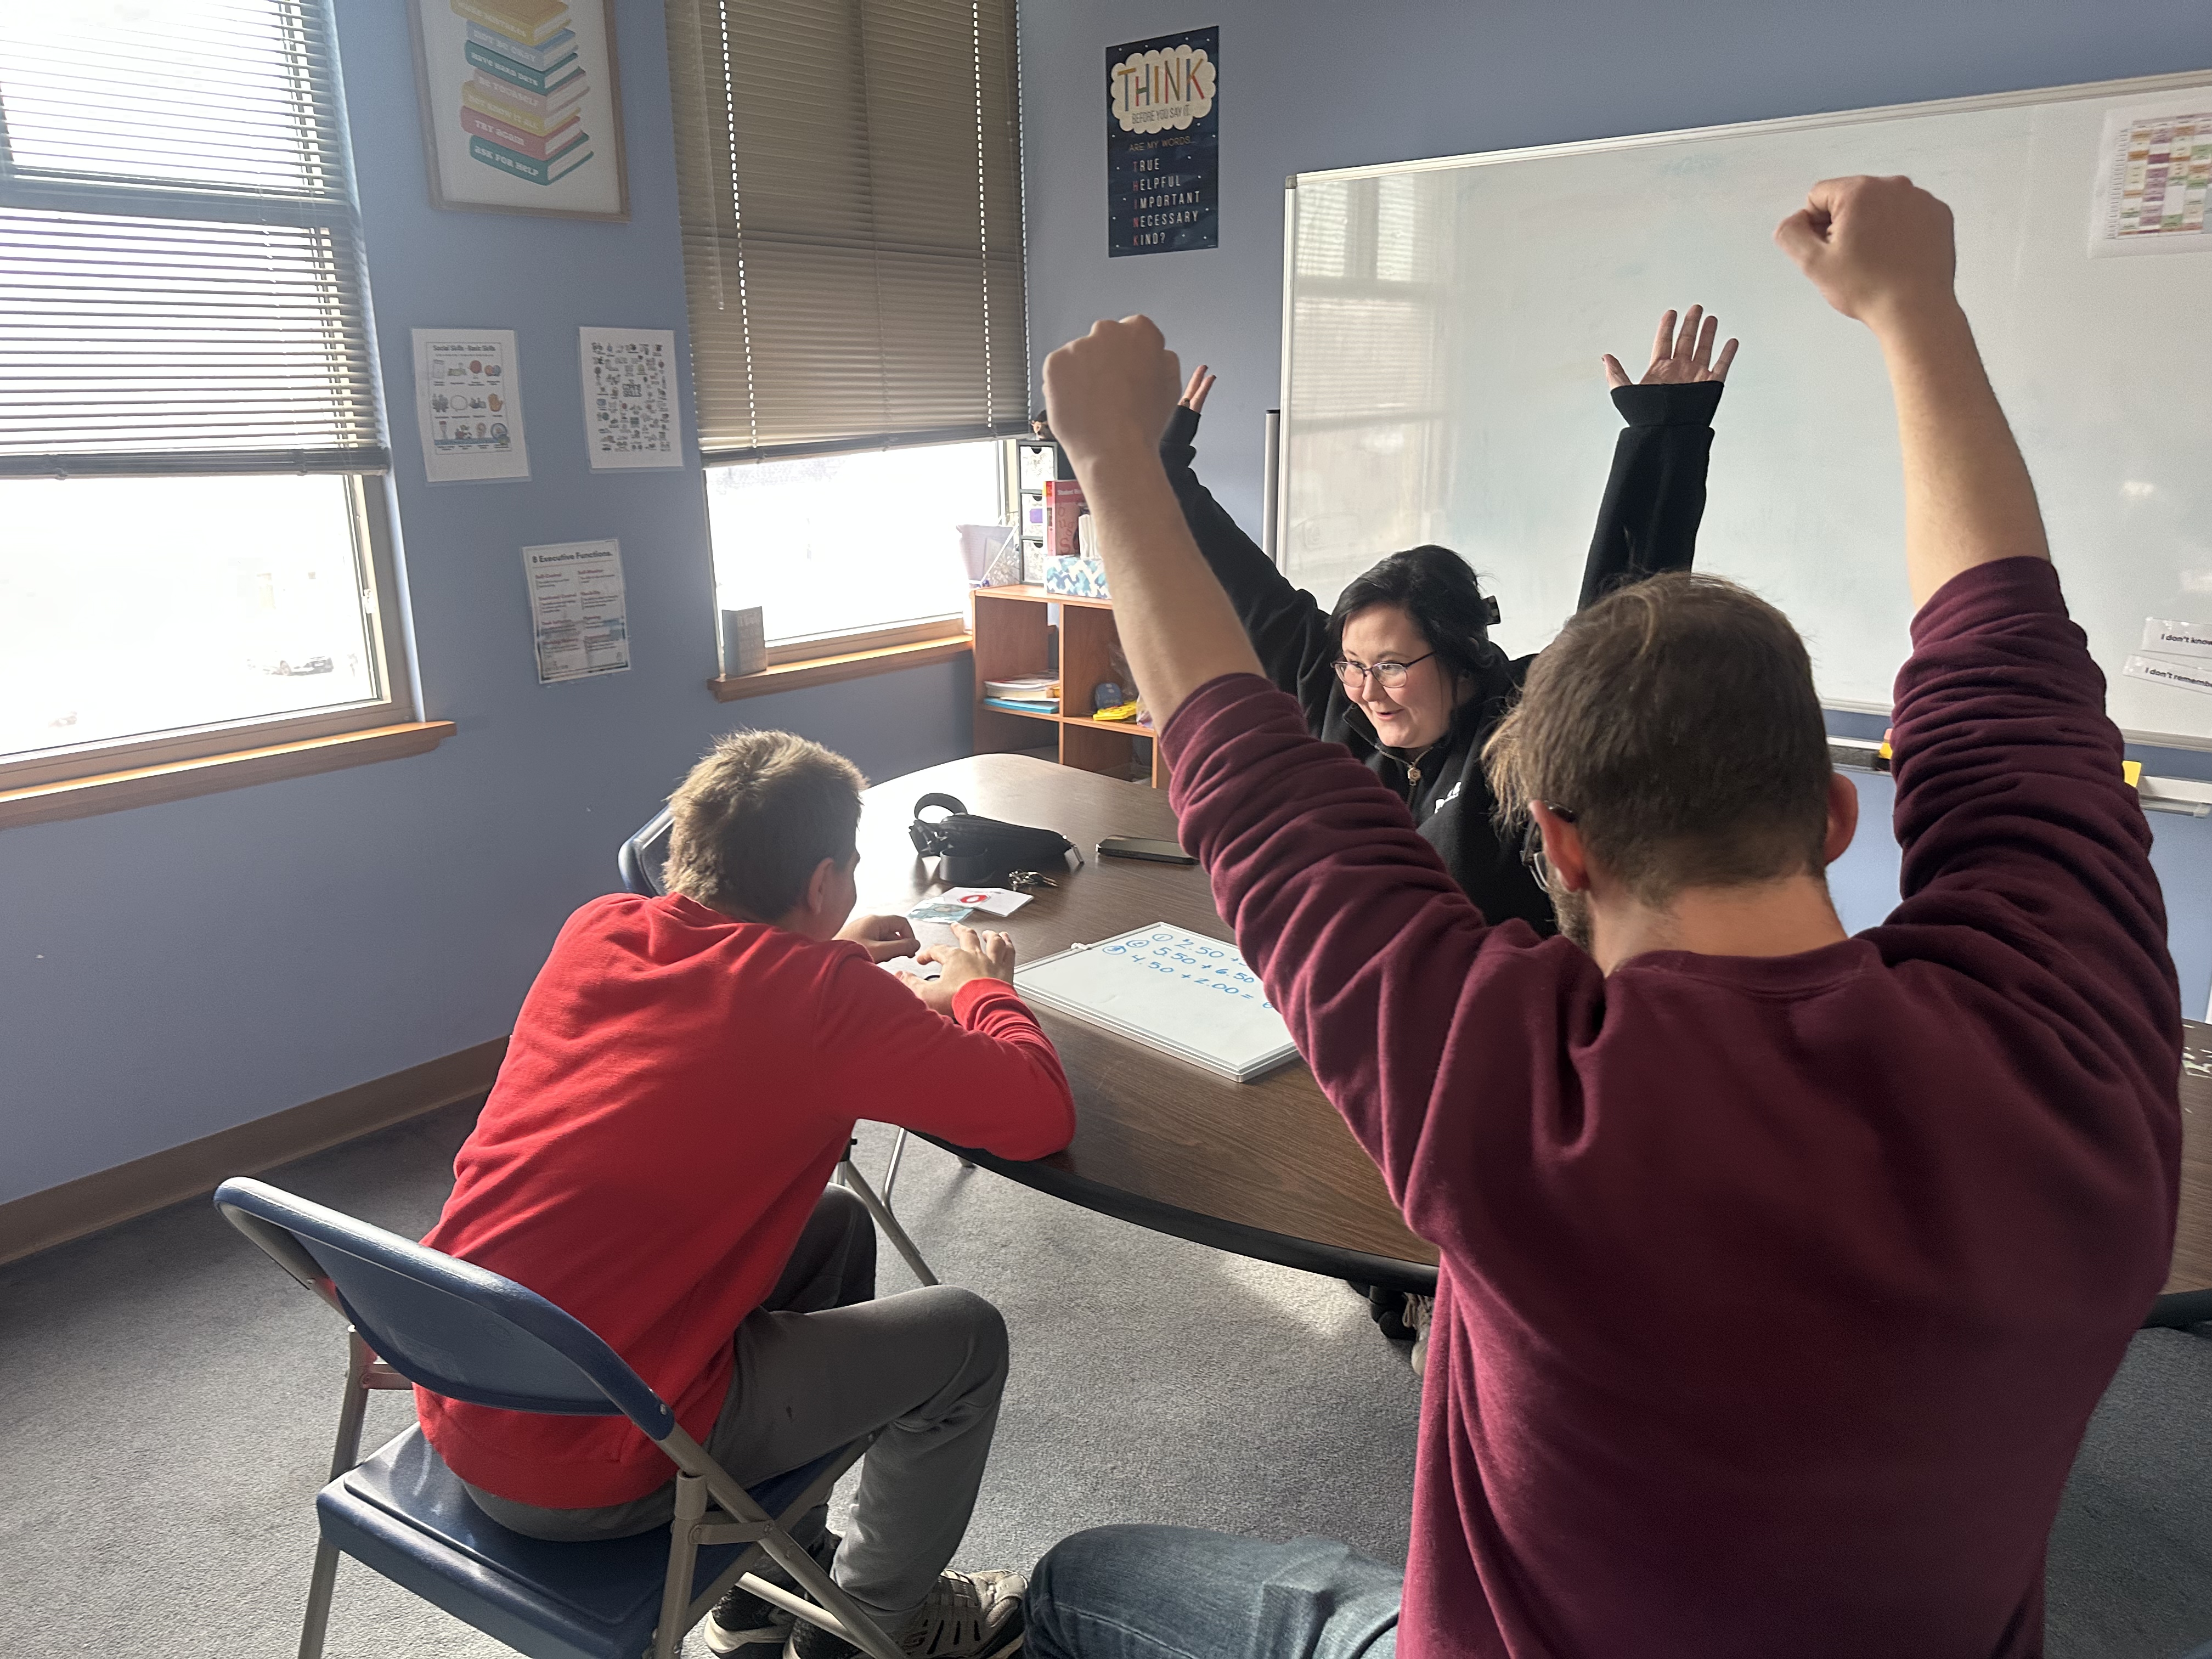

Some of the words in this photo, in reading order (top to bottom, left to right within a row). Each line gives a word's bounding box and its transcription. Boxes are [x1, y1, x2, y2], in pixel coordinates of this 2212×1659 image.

[1118, 58, 1205, 111] THINK
[1132, 110, 1155, 124] BEFORE
[1156, 109, 1169, 121] YOU
[1170, 106, 1183, 118] SAY
[1129, 142, 1145, 151] ARE
[1147, 140, 1159, 149] MY
[1133, 158, 1160, 173] TRUE
[1133, 175, 1181, 191] HELPFUL
[1133, 191, 1200, 210] IMPORTANT
[1133, 211, 1198, 228] NECESSARY
[1133, 232, 1165, 246] KIND?
[539, 553, 574, 563] Executive
[2149, 669, 2172, 679] don't
[1153, 947, 1197, 964] 5.50
[1215, 968, 1255, 983] 6.50
[1131, 954, 1175, 973] 4.50
[1194, 978, 1239, 994] 2.00
